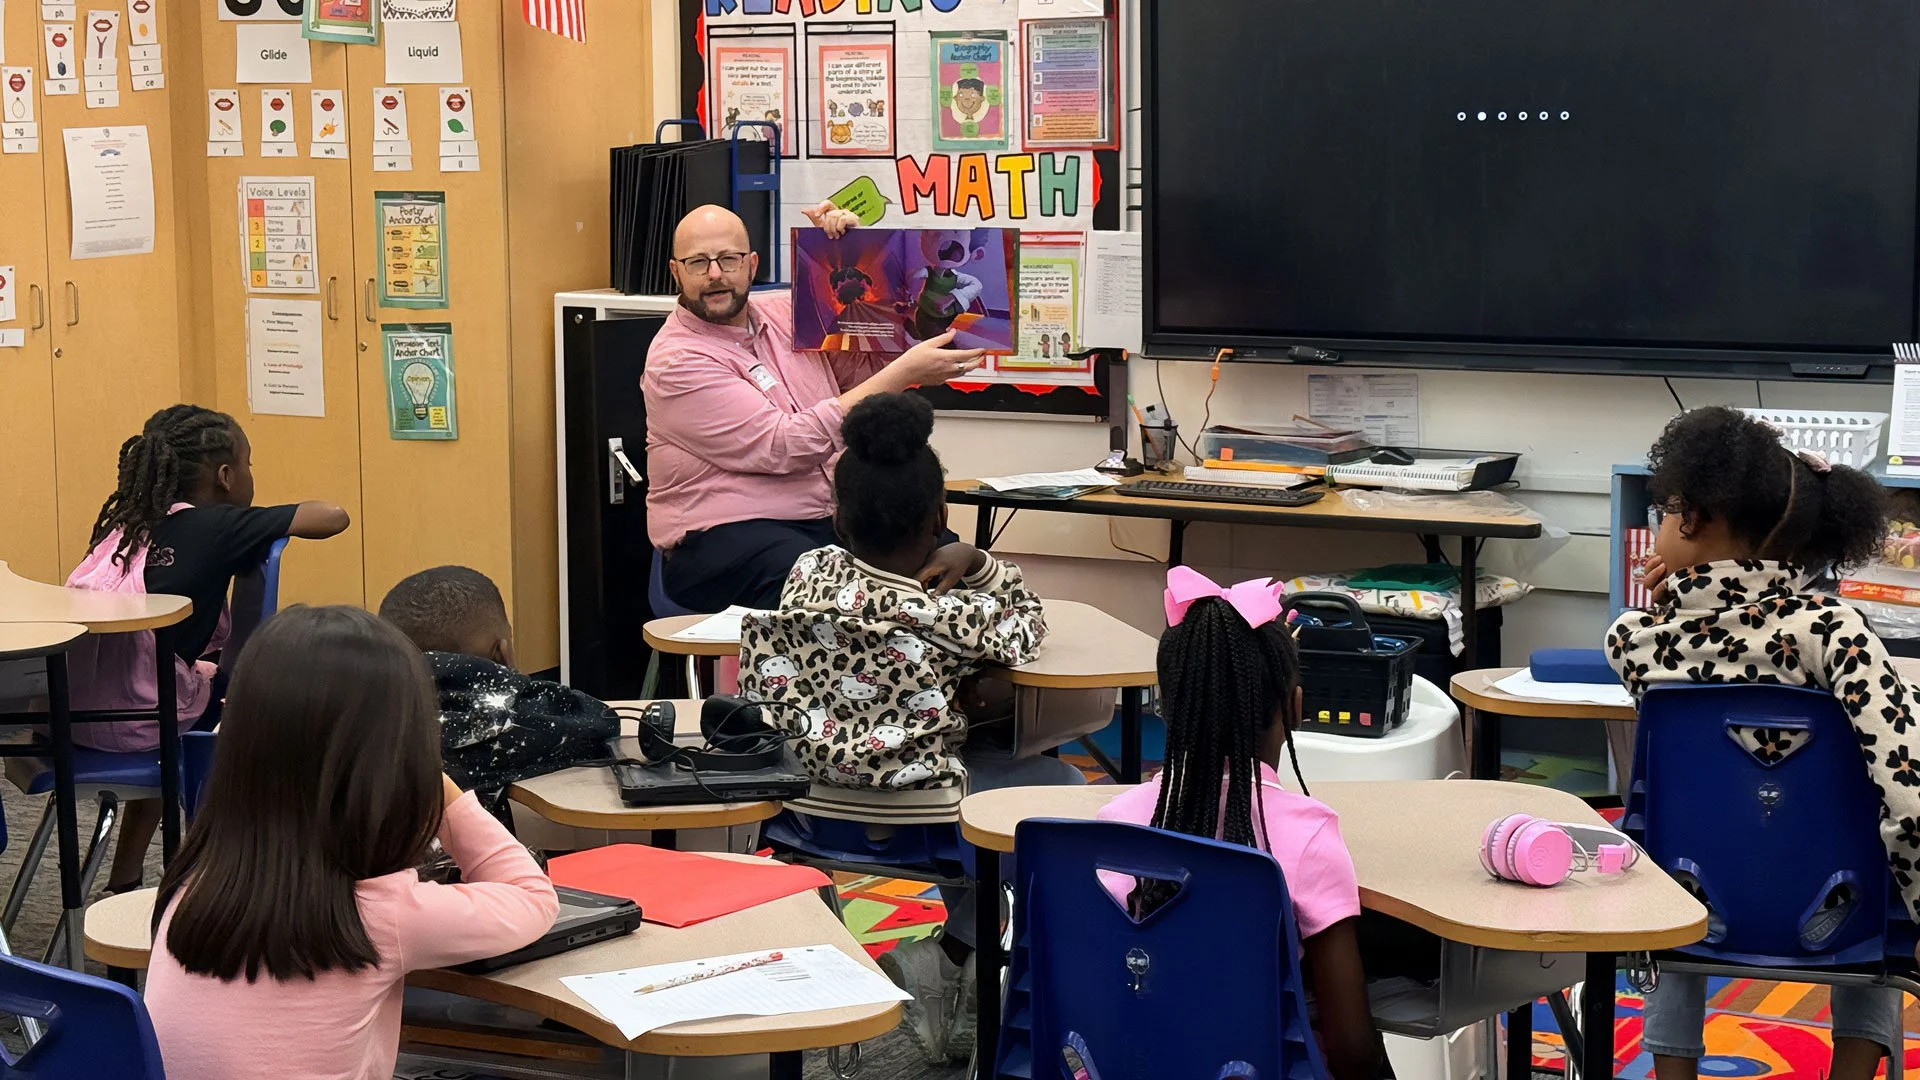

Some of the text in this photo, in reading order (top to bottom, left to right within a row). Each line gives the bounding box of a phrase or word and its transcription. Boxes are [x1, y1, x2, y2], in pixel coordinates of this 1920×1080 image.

[260, 49, 288, 61] Glide
[408, 46, 439, 59] Liquid
[323, 147, 335, 156] wh
[896, 152, 1080, 221] MATH
[249, 187, 306, 197] Voice Levels
[389, 215, 434, 224] Anchor Chart
[395, 347, 440, 357] Anchor Chart
